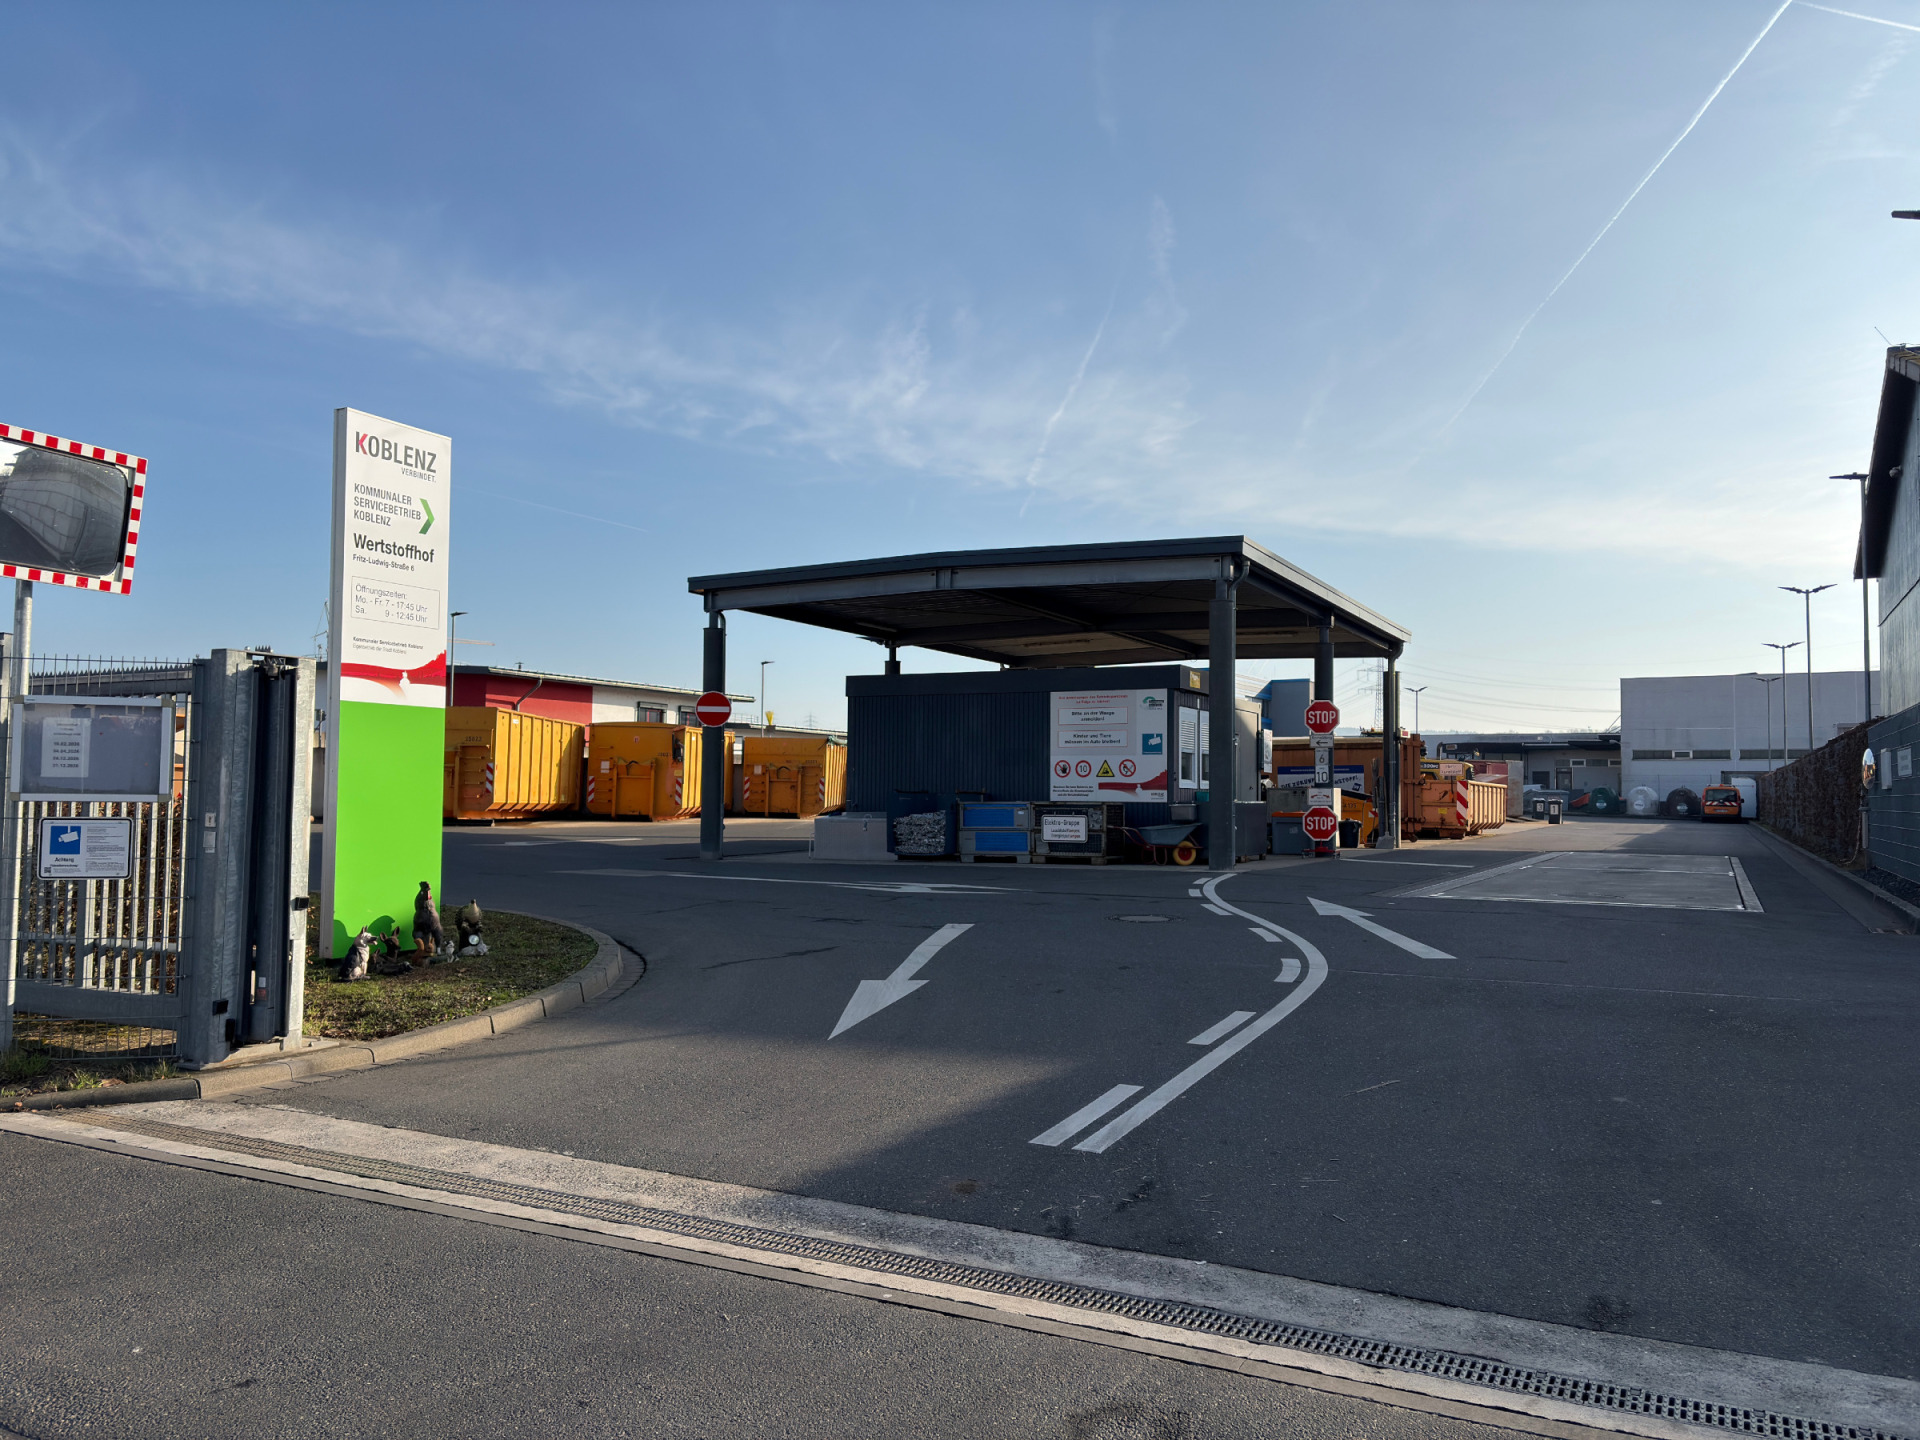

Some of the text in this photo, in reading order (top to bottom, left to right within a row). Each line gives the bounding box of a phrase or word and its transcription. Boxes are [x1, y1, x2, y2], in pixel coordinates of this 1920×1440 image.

[355, 431, 437, 474] KOBLENZ
[401, 467, 437, 483] VERBINDET.
[354, 483, 412, 506] KOMMUNALER
[353, 496, 422, 521] SERVICEBETRIEB
[353, 509, 391, 527] KOBLENZ
[353, 532, 435, 563] Wertstoffhof
[353, 553, 410, 571] Fritz-Ludwig-Straße
[355, 583, 407, 600] Öffnungszeiten:
[355, 594, 369, 604] Mo.
[374, 597, 383, 606] Fr.
[396, 601, 414, 612] 17:45
[416, 603, 428, 613] Uhr
[355, 605, 367, 614] Sa.
[385, 609, 390, 618] 9
[396, 611, 415, 621] 12:45
[415, 614, 428, 623] Uhr
[1308, 711, 1336, 724] STOP
[1319, 754, 1325, 764] 6
[1079, 765, 1088, 773] 10
[1316, 771, 1328, 783] 10
[1306, 816, 1335, 831] STOP
